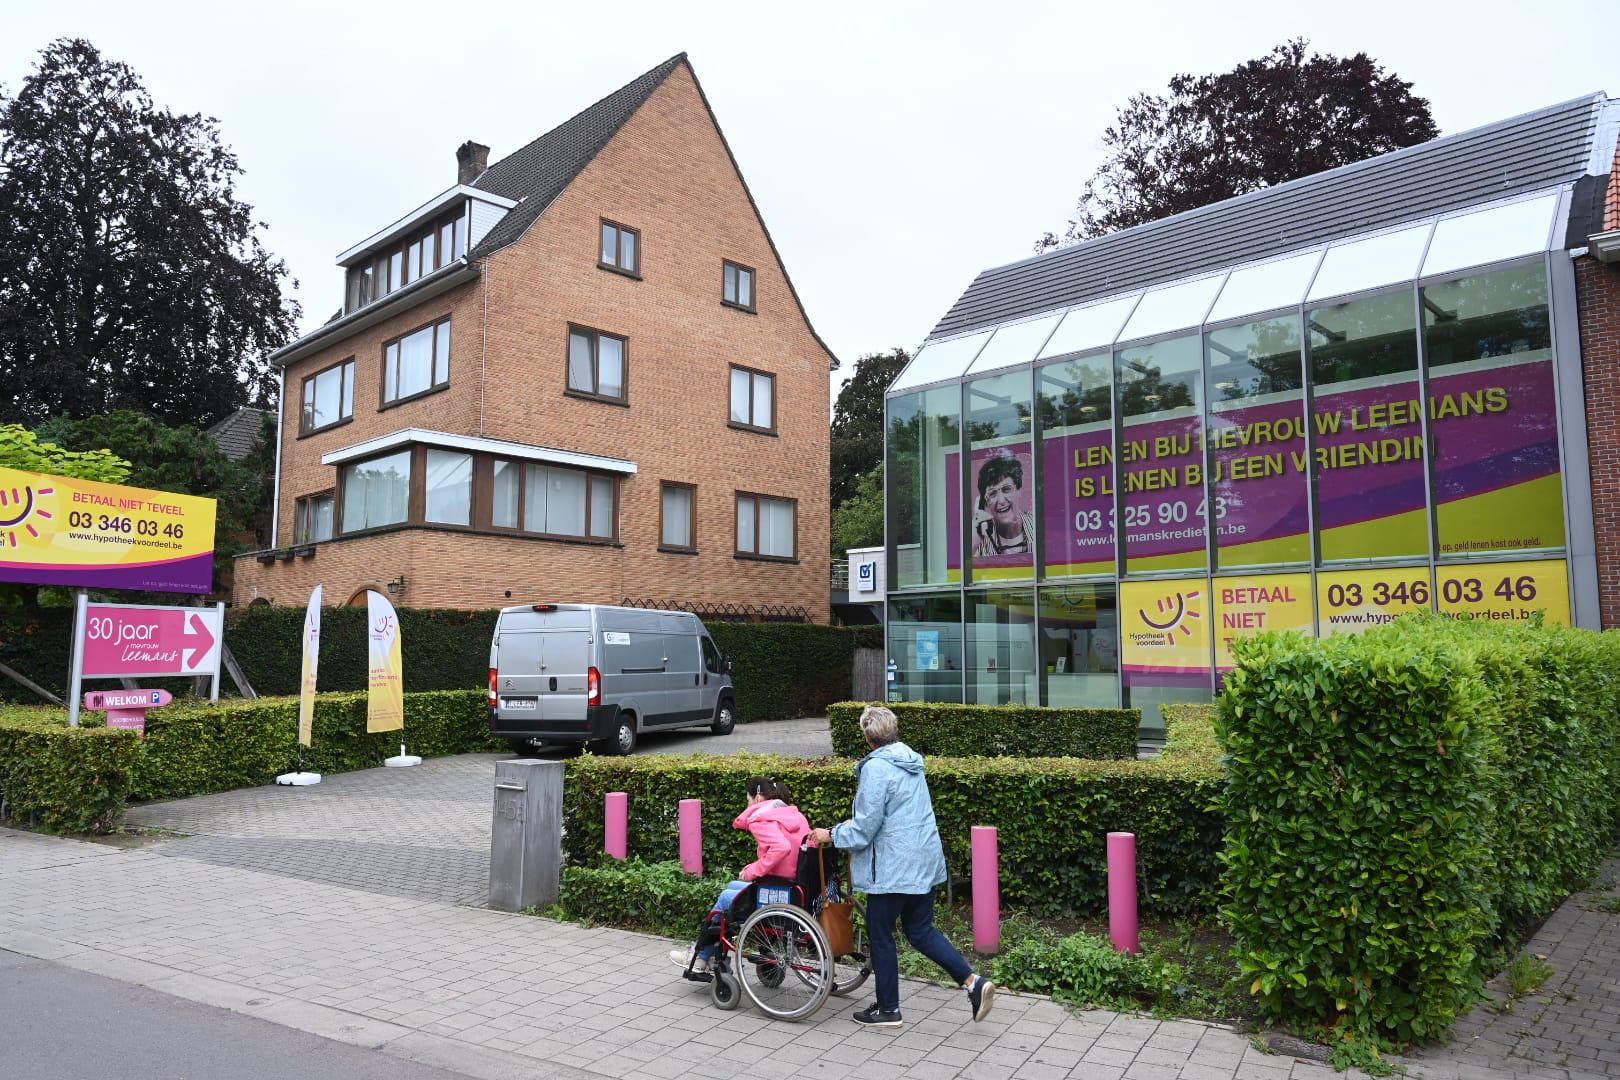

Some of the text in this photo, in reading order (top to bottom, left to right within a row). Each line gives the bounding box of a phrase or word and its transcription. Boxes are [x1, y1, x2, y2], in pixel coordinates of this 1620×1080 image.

[1155, 432, 1191, 458] BIJ
[1352, 386, 1508, 430] LEEMANS
[1075, 477, 1095, 497] IS
[1102, 467, 1177, 494] LNEN
[1185, 460, 1222, 485] BJ
[1231, 453, 1283, 480] EEN
[73, 492, 184, 516] BETAAL NIET TEVEEL
[1075, 510, 1102, 531] 03
[1158, 501, 1188, 524] 90
[69, 511, 184, 539] 03 346 03 46
[69, 532, 183, 550] www.hypotheekvoordeel.be
[1455, 541, 1469, 552] geld
[1471, 541, 1490, 550] lenen
[1222, 586, 1297, 604] BETAAL
[1328, 576, 1537, 607] 03 346 03 46
[88, 617, 159, 645] 30 jaar
[1222, 612, 1266, 629] NIET
[1129, 632, 1165, 640] Hypotheek
[105, 693, 159, 706] WELKOM P
